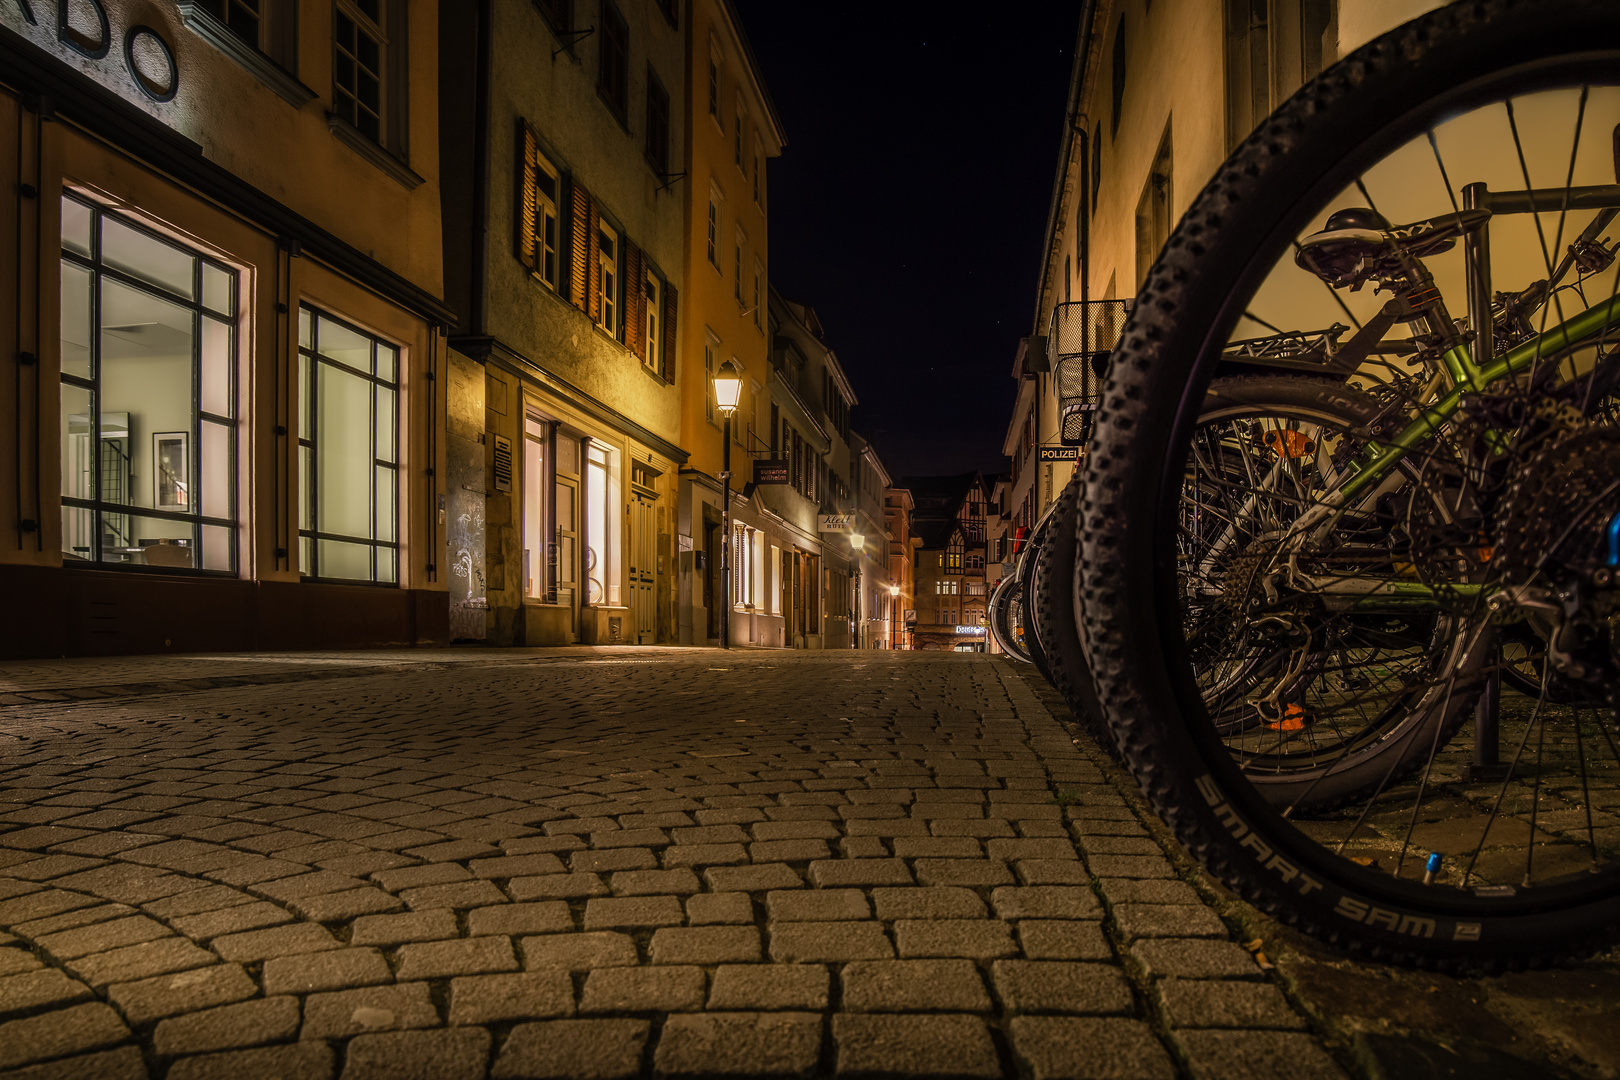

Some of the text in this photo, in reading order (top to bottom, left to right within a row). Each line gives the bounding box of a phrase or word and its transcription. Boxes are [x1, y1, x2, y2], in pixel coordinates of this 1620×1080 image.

[17, 0, 179, 103] DO
[1041, 450, 1077, 459] POLIZEI
[1195, 773, 1436, 938] SMART SAM
